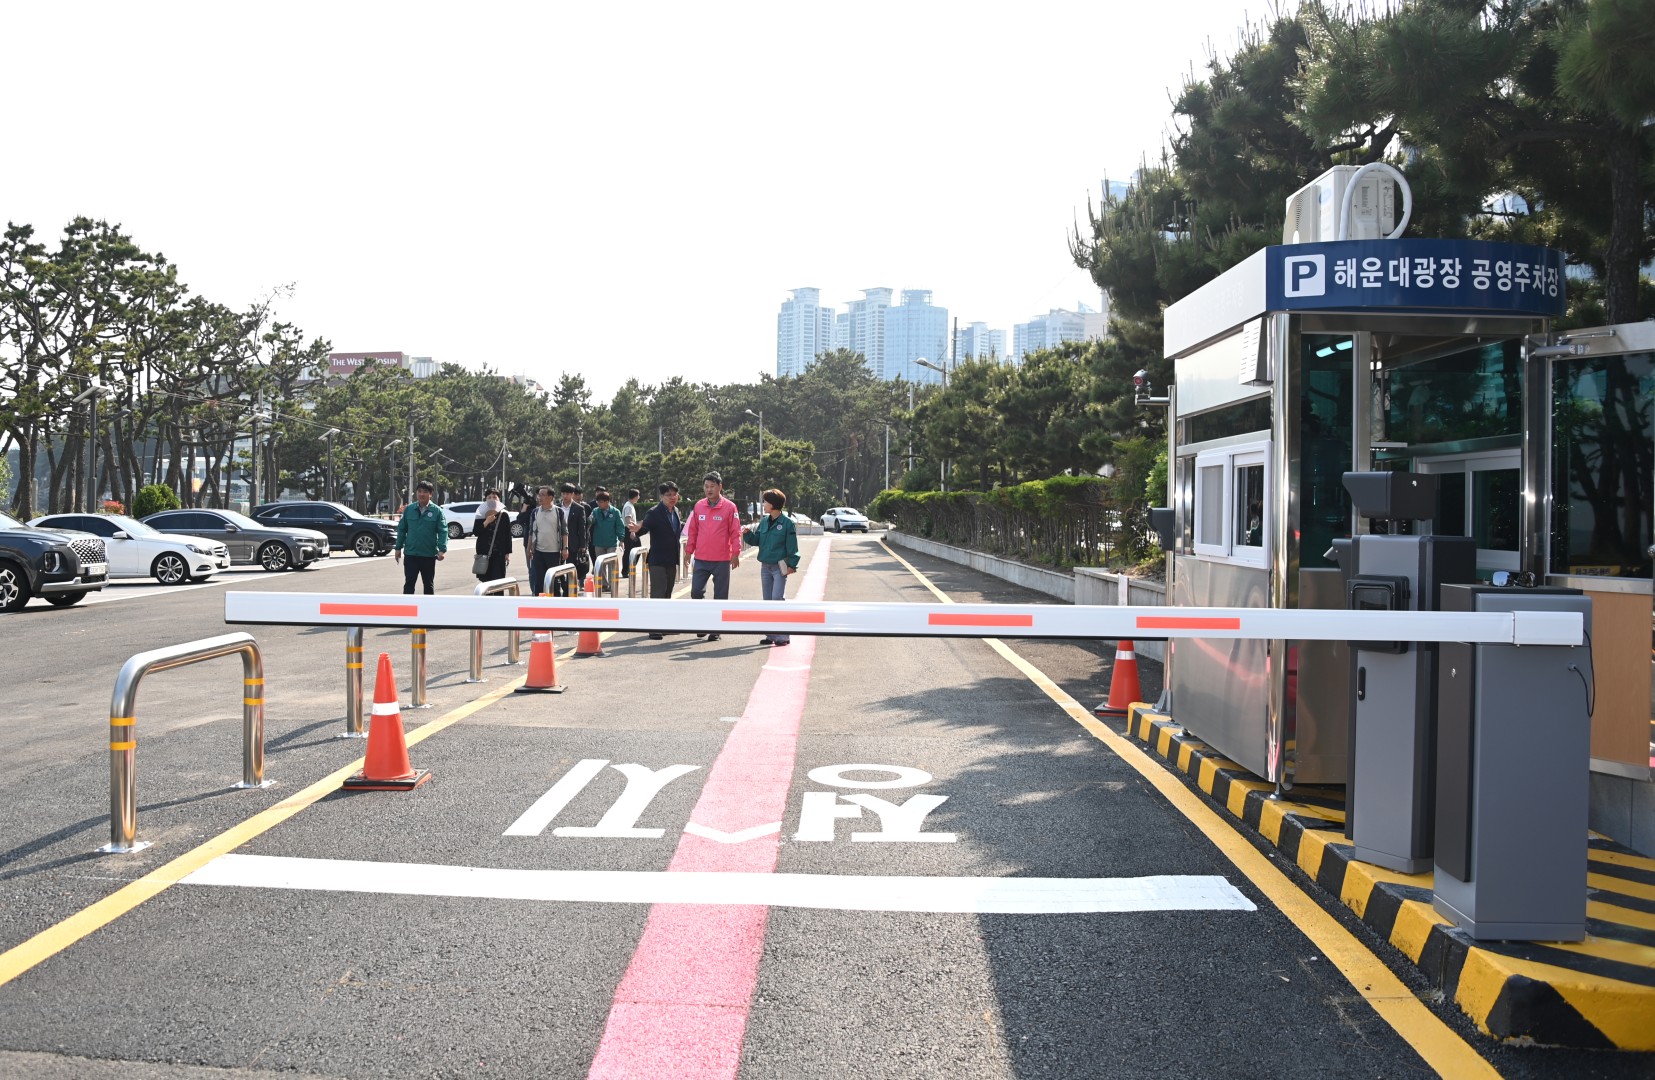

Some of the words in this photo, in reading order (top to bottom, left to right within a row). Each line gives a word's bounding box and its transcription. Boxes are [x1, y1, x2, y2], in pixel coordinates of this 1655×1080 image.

[1291, 260, 1318, 292] P
[1334, 256, 1463, 289] 해운대광장
[1471, 258, 1559, 298] 공영주차장
[332, 358, 346, 366] THE
